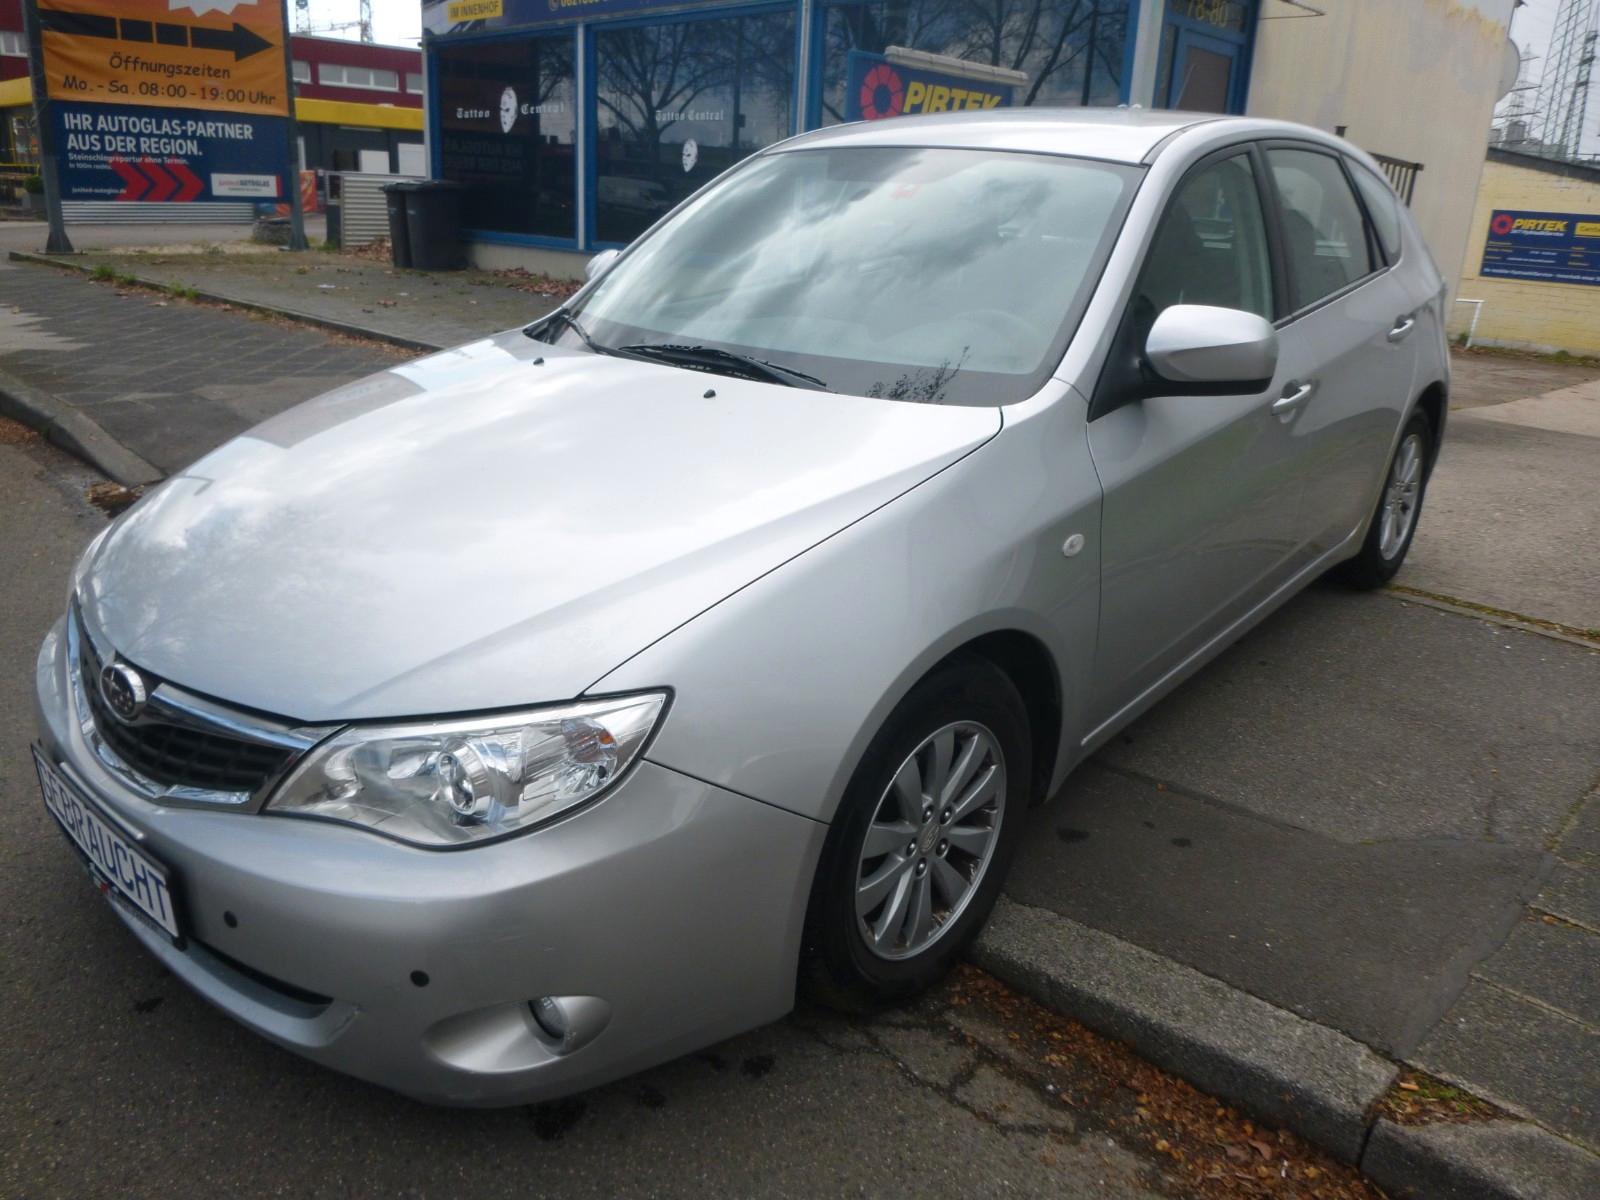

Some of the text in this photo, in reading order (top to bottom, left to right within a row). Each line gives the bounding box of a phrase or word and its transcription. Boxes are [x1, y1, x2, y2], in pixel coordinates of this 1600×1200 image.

[109, 52, 231, 79] Öffnungszeiten
[63, 75, 94, 91] Mo.
[108, 80, 135, 95] Sa.
[249, 91, 276, 104] Uhr
[456, 103, 564, 119] Tattoo Central
[656, 109, 723, 120] Tattoo Central
[64, 113, 253, 140] IHR AUTOGLAS-PARTNER
[67, 133, 203, 156] AUS DER REGION.
[1512, 219, 1568, 231] PIRTEK
[38, 761, 168, 922] GEBRAUCHT
